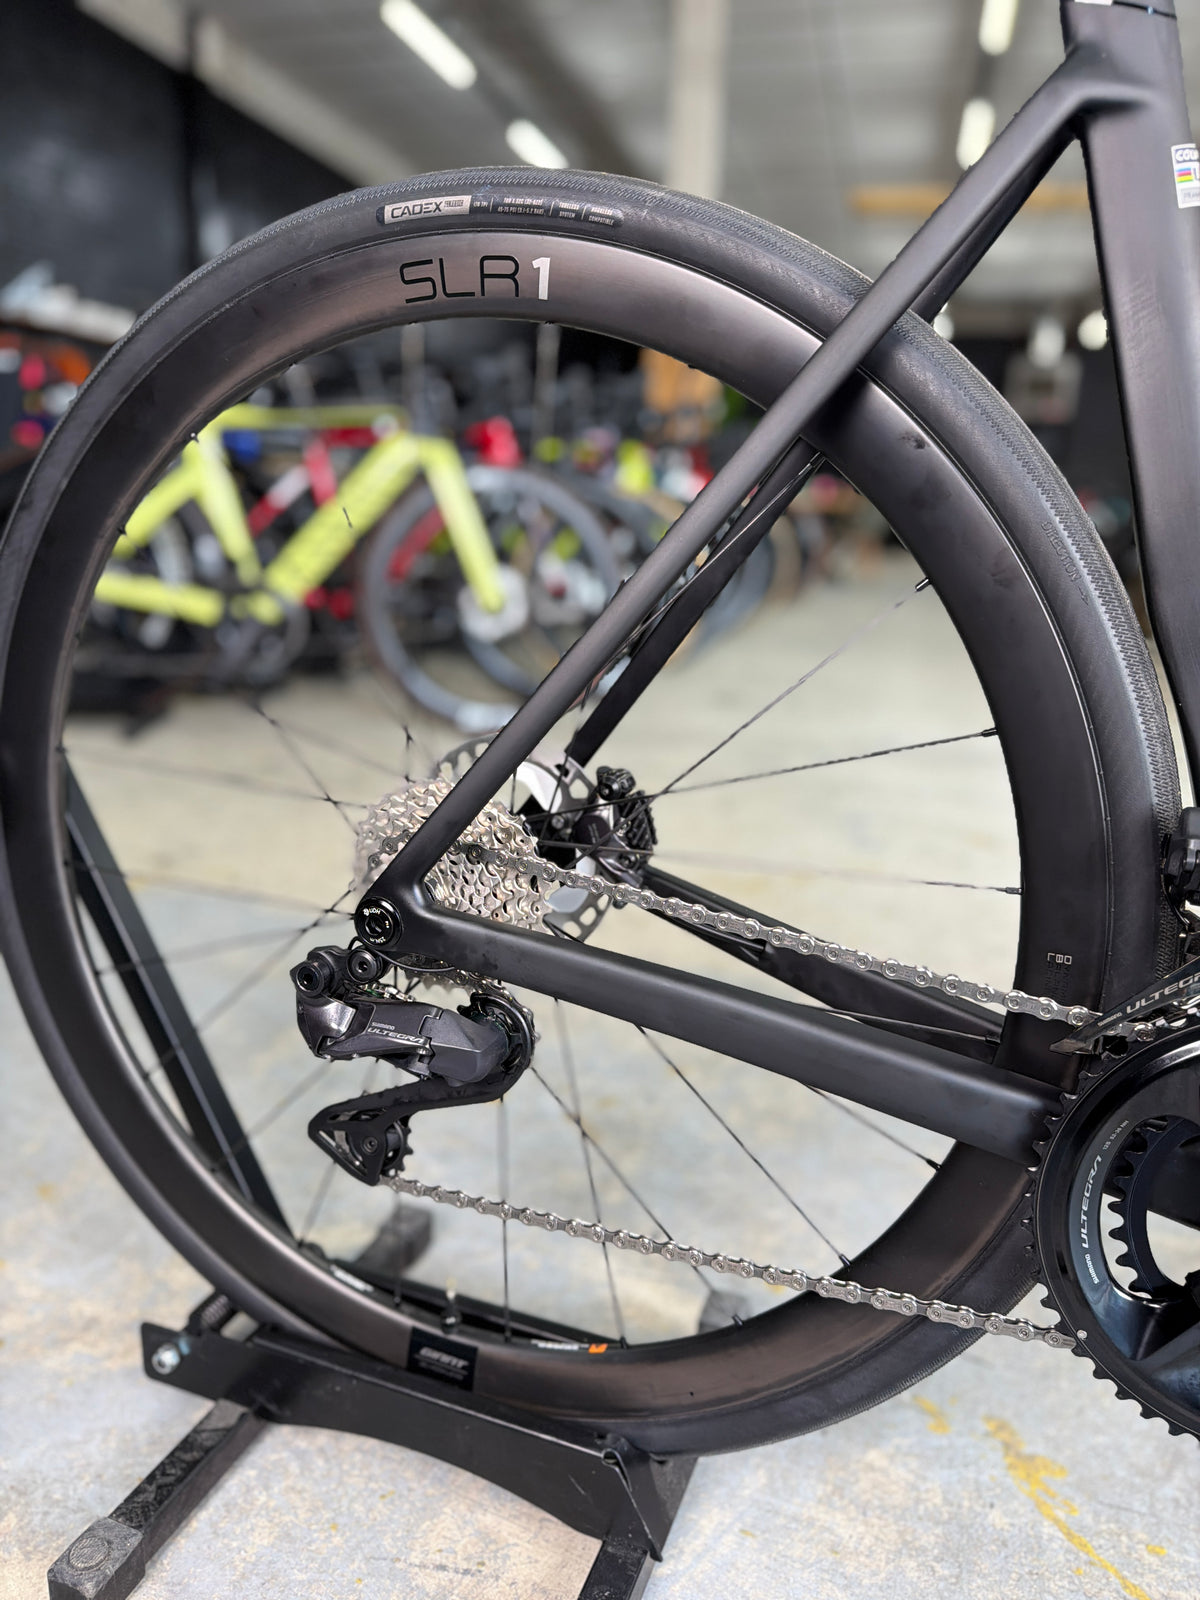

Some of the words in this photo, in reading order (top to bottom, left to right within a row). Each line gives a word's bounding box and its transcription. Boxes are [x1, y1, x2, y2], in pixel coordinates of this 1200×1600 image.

[391, 201, 443, 219] CADEX
[588, 215, 615, 226] COMPATIBLE
[400, 255, 519, 304] SLR
[532, 257, 551, 300] 1
[1041, 521, 1082, 582] DIRECTION
[367, 1027, 425, 1044] ULTEGRA
[1081, 1154, 1103, 1249] ULTEGRA
[1084, 1253, 1100, 1285] SHIMANO
